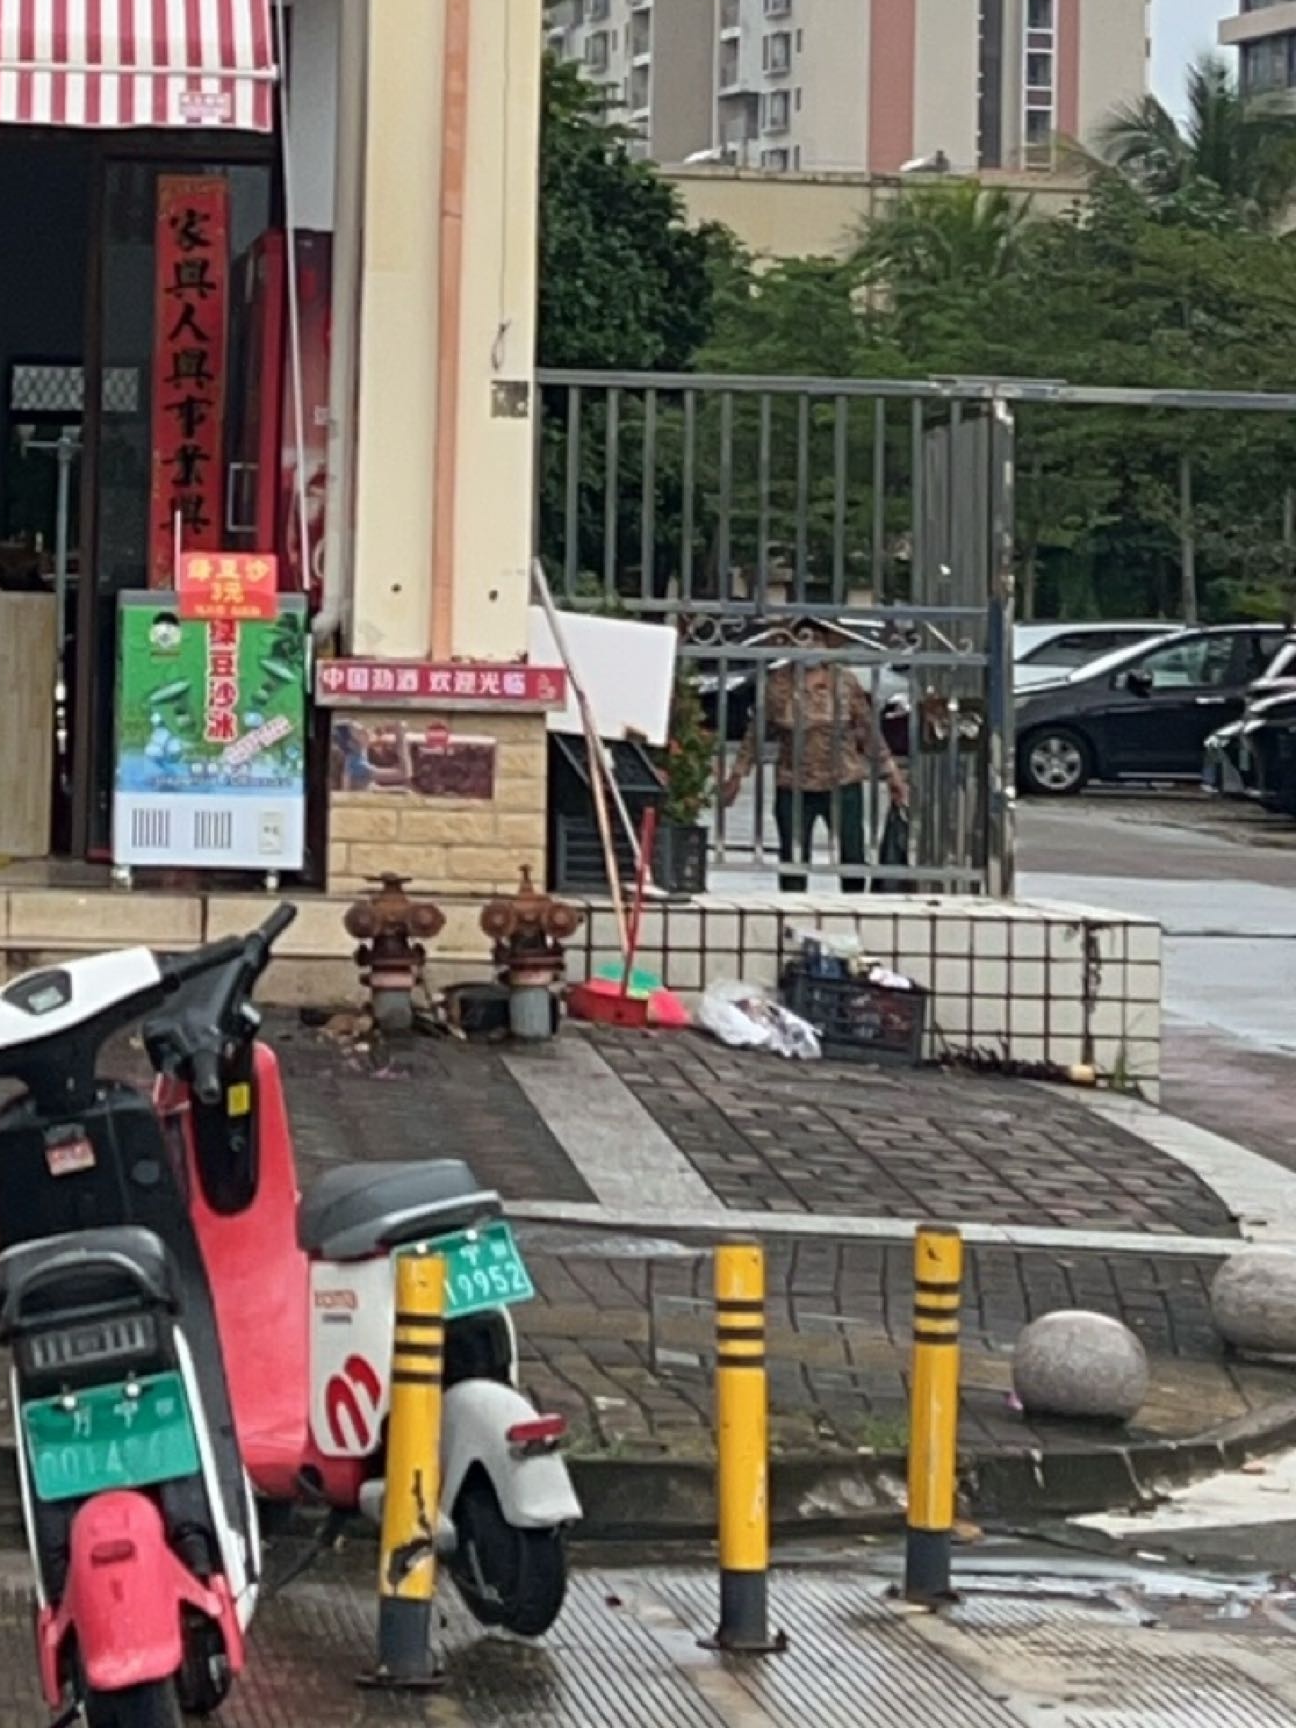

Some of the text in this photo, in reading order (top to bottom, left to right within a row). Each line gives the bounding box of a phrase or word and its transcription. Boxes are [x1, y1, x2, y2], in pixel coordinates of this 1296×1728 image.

[322, 666, 527, 695] 中国劲酒 欢迎光临
